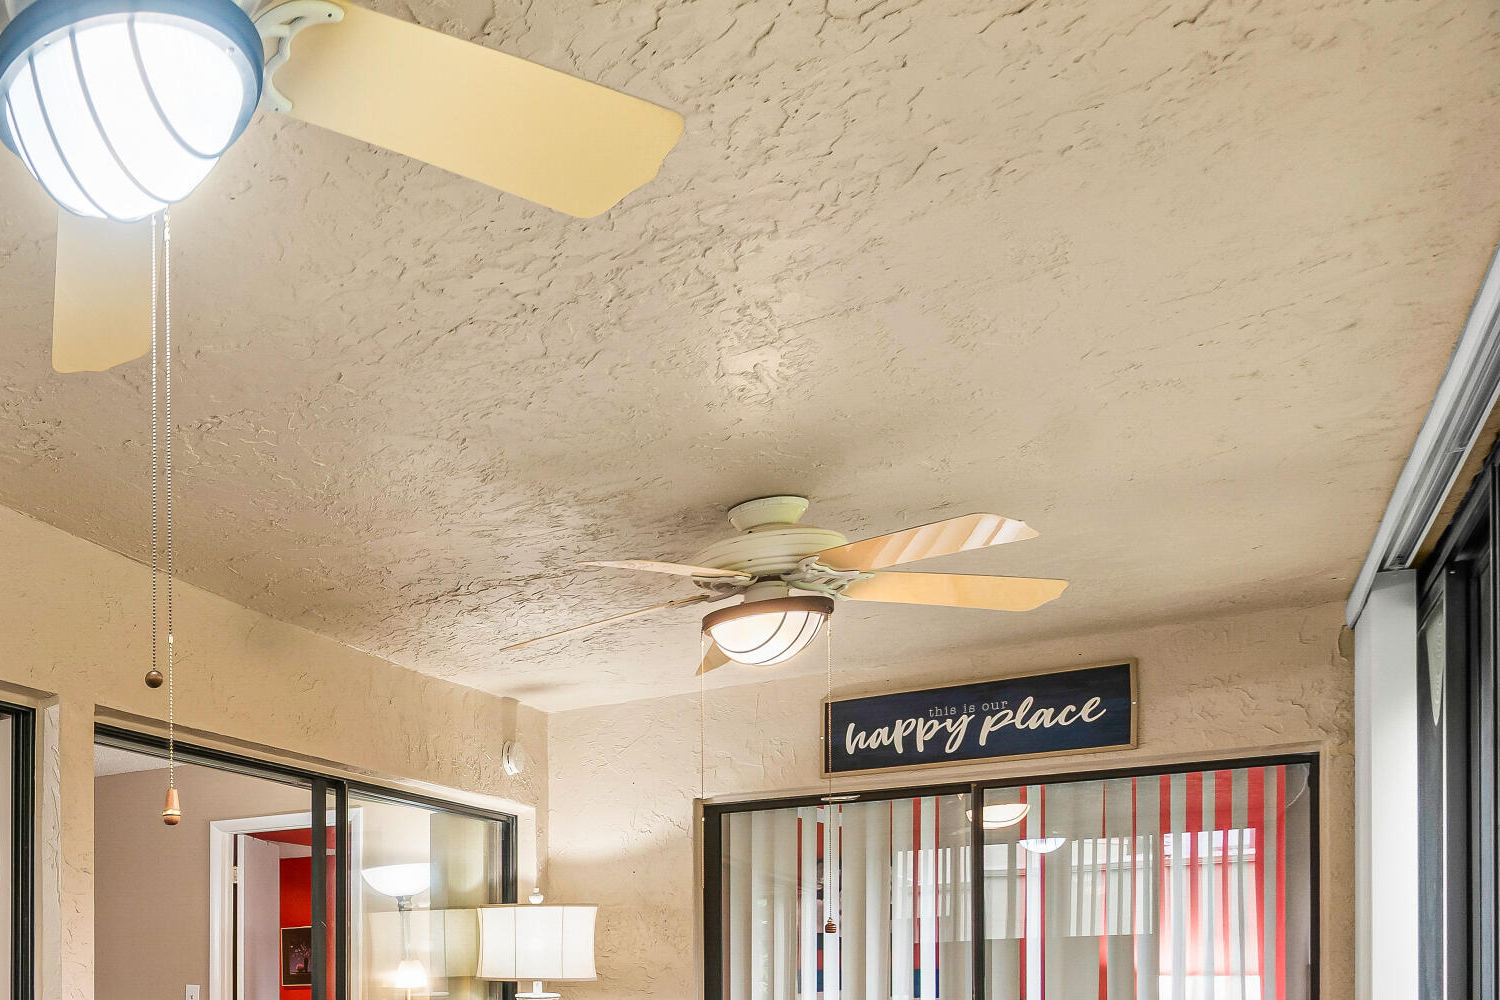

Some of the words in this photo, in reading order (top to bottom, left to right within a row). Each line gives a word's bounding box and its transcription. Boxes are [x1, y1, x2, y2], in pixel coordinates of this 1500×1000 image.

[845, 713, 976, 754] happy
[978, 696, 1107, 746] place
[928, 705, 957, 718] this
[963, 703, 976, 714] is
[981, 700, 1008, 712] our
